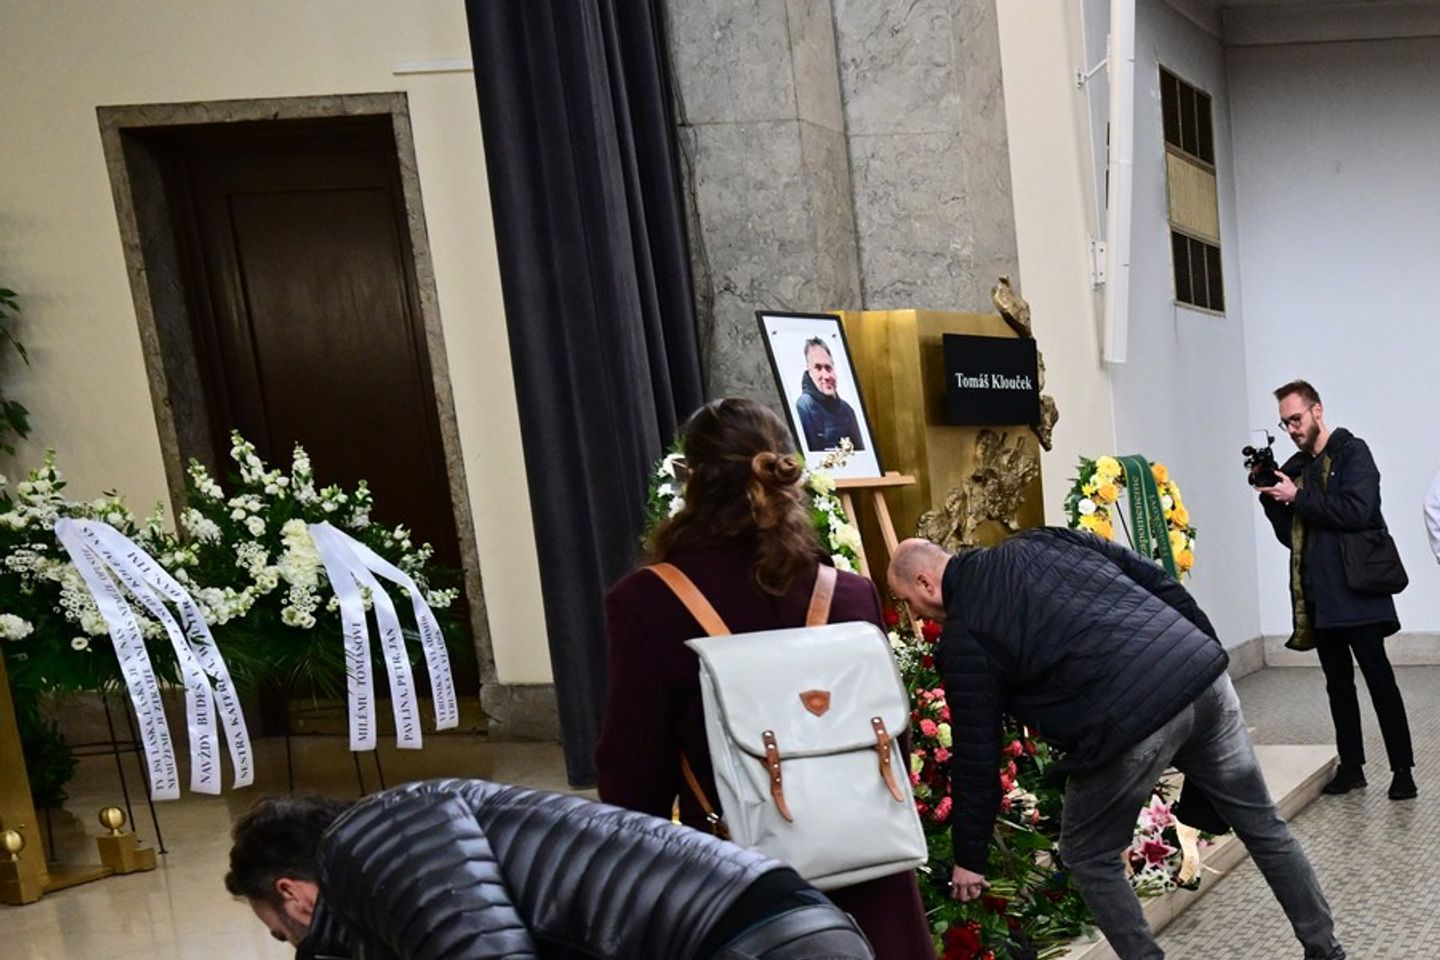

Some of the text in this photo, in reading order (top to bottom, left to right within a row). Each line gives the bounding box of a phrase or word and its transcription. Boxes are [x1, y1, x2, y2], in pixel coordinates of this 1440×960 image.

[955, 372, 1033, 390] Tomáš Klouček
[386, 628, 398, 651] JAN
[191, 683, 207, 725] BUDEŠ
[351, 622, 368, 742] MILÉMU TOMÁŠOVI
[434, 673, 446, 722] VERONIKA
[399, 688, 413, 741] PAVLÍNA,
[197, 733, 211, 784] NAVŽDY
[234, 732, 249, 779] SESTRA
[155, 778, 164, 791] TY
